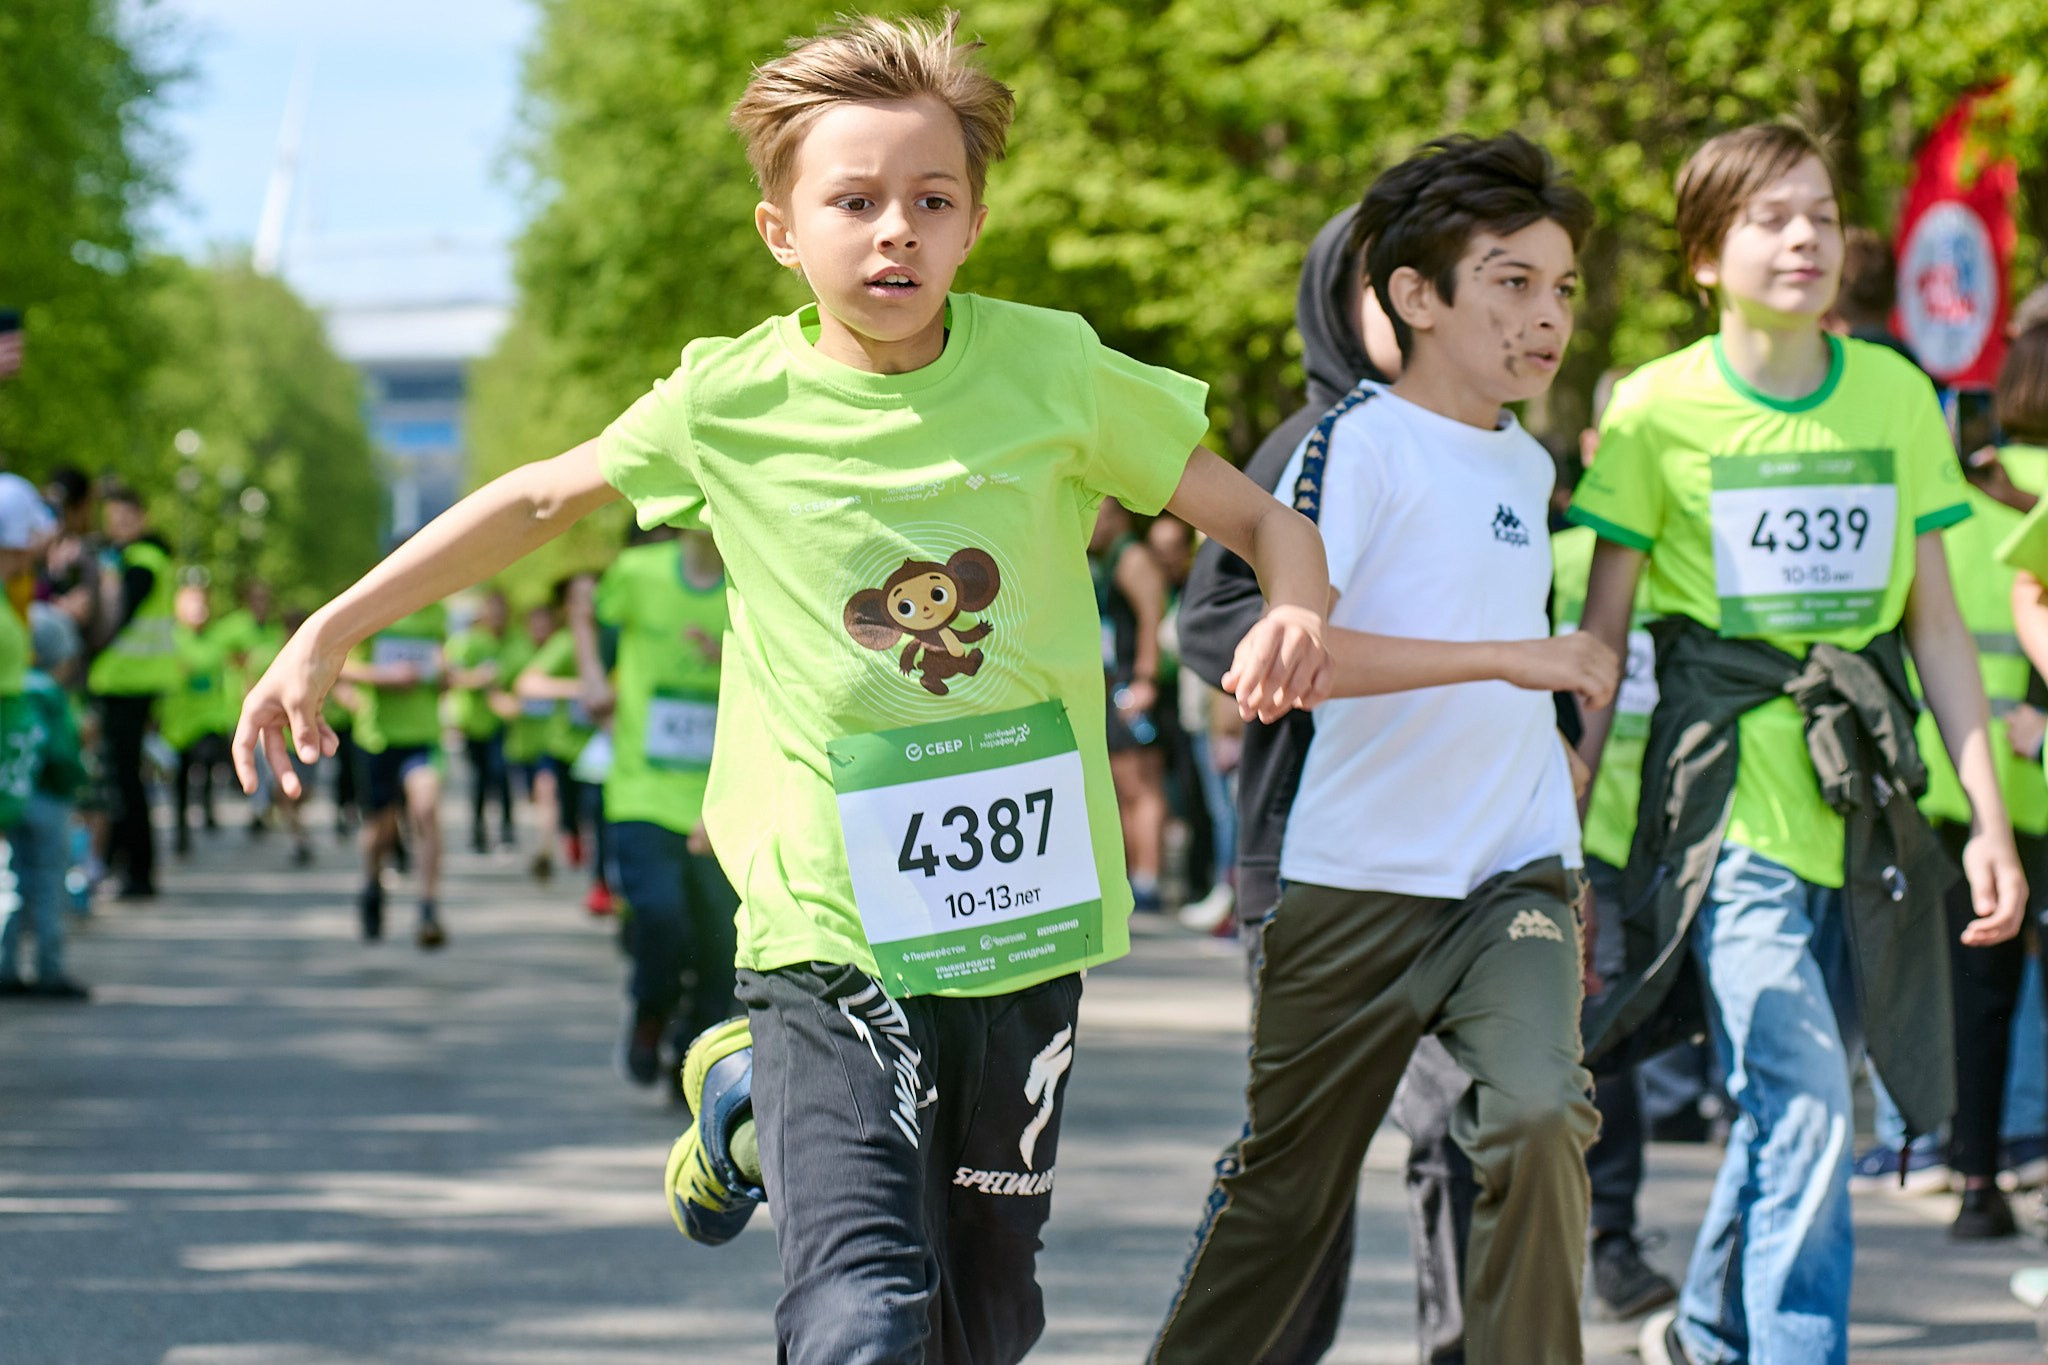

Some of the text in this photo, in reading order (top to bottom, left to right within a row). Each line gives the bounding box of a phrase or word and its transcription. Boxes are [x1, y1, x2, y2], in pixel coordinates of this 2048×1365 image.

[1751, 507, 1869, 553] 4339
[925, 739, 963, 756] СБЕР
[979, 737, 1015, 750] марафон
[898, 788, 1054, 877] 4387
[945, 884, 1041, 919] 10-13 лет
[910, 944, 967, 963] Перекрёсток
